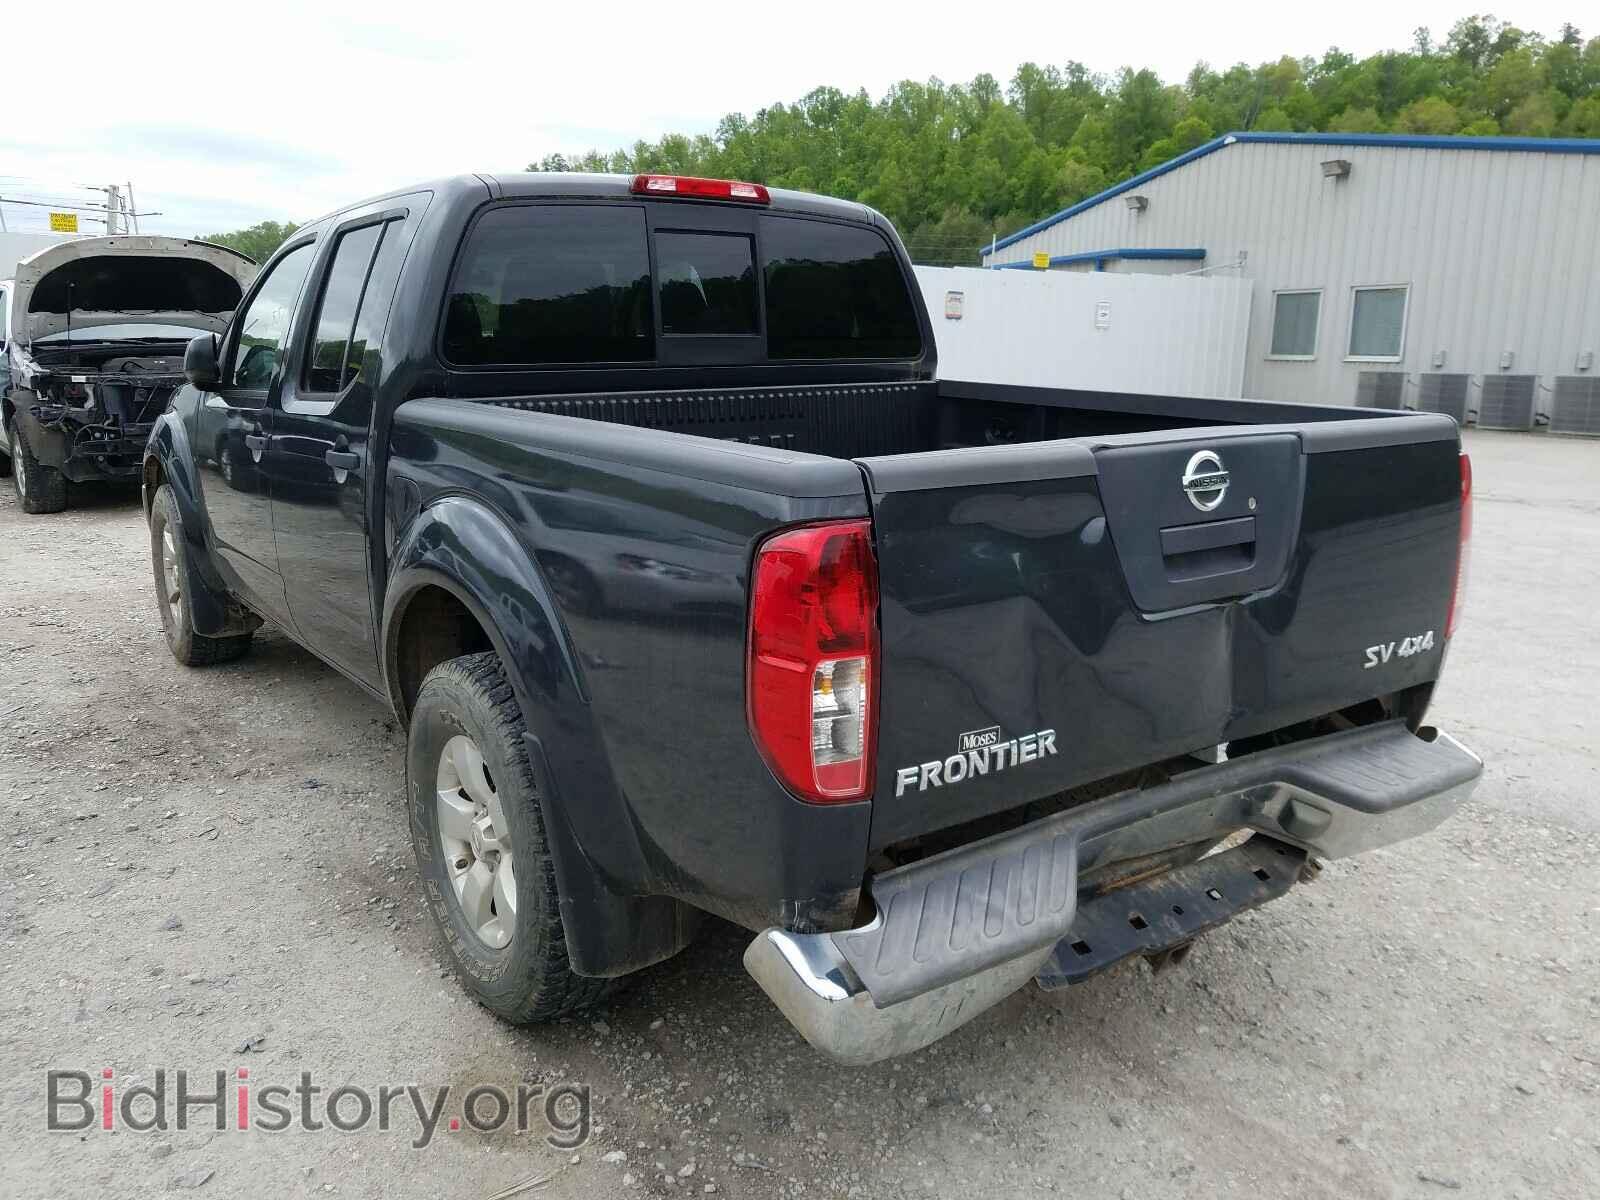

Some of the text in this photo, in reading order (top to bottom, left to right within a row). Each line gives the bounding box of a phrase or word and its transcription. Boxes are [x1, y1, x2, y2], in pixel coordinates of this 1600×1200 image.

[1363, 642, 1396, 669] SV
[962, 731, 997, 750] MOSES
[895, 729, 1058, 798] FRONTIER
